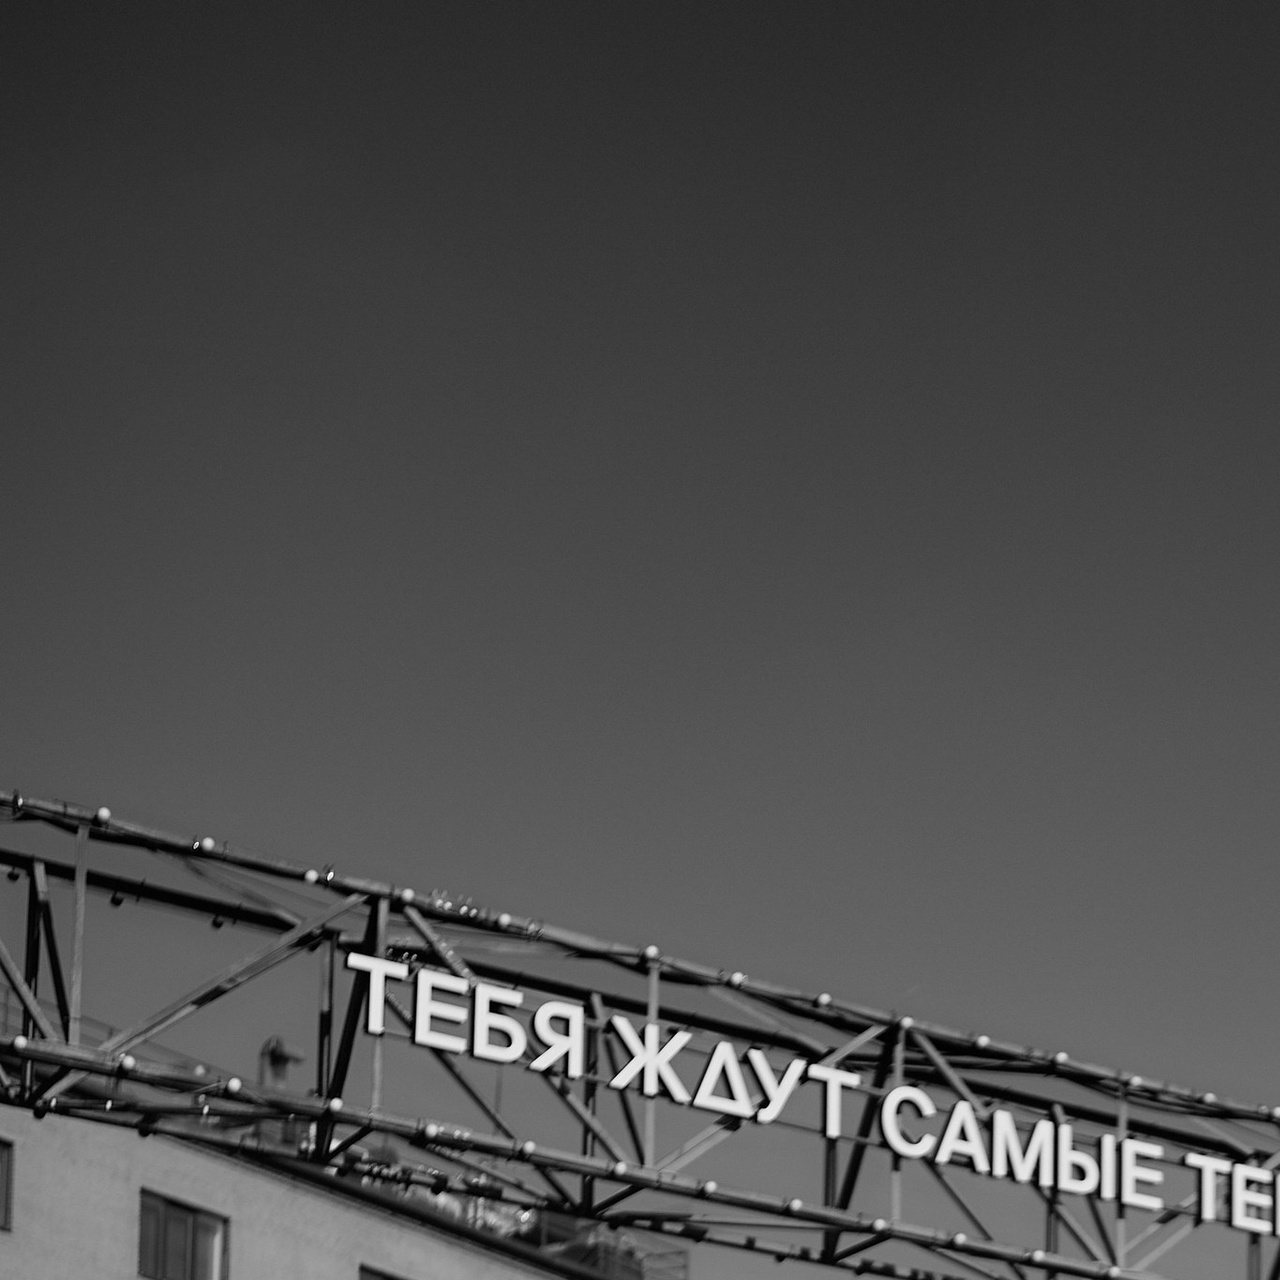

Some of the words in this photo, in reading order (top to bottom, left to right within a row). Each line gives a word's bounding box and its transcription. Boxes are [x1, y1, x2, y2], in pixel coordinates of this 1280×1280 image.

[346, 951, 585, 1078] ТЕБЯ
[609, 1014, 862, 1139] ЖДУТ
[881, 1084, 1165, 1211] САМЫЕ
